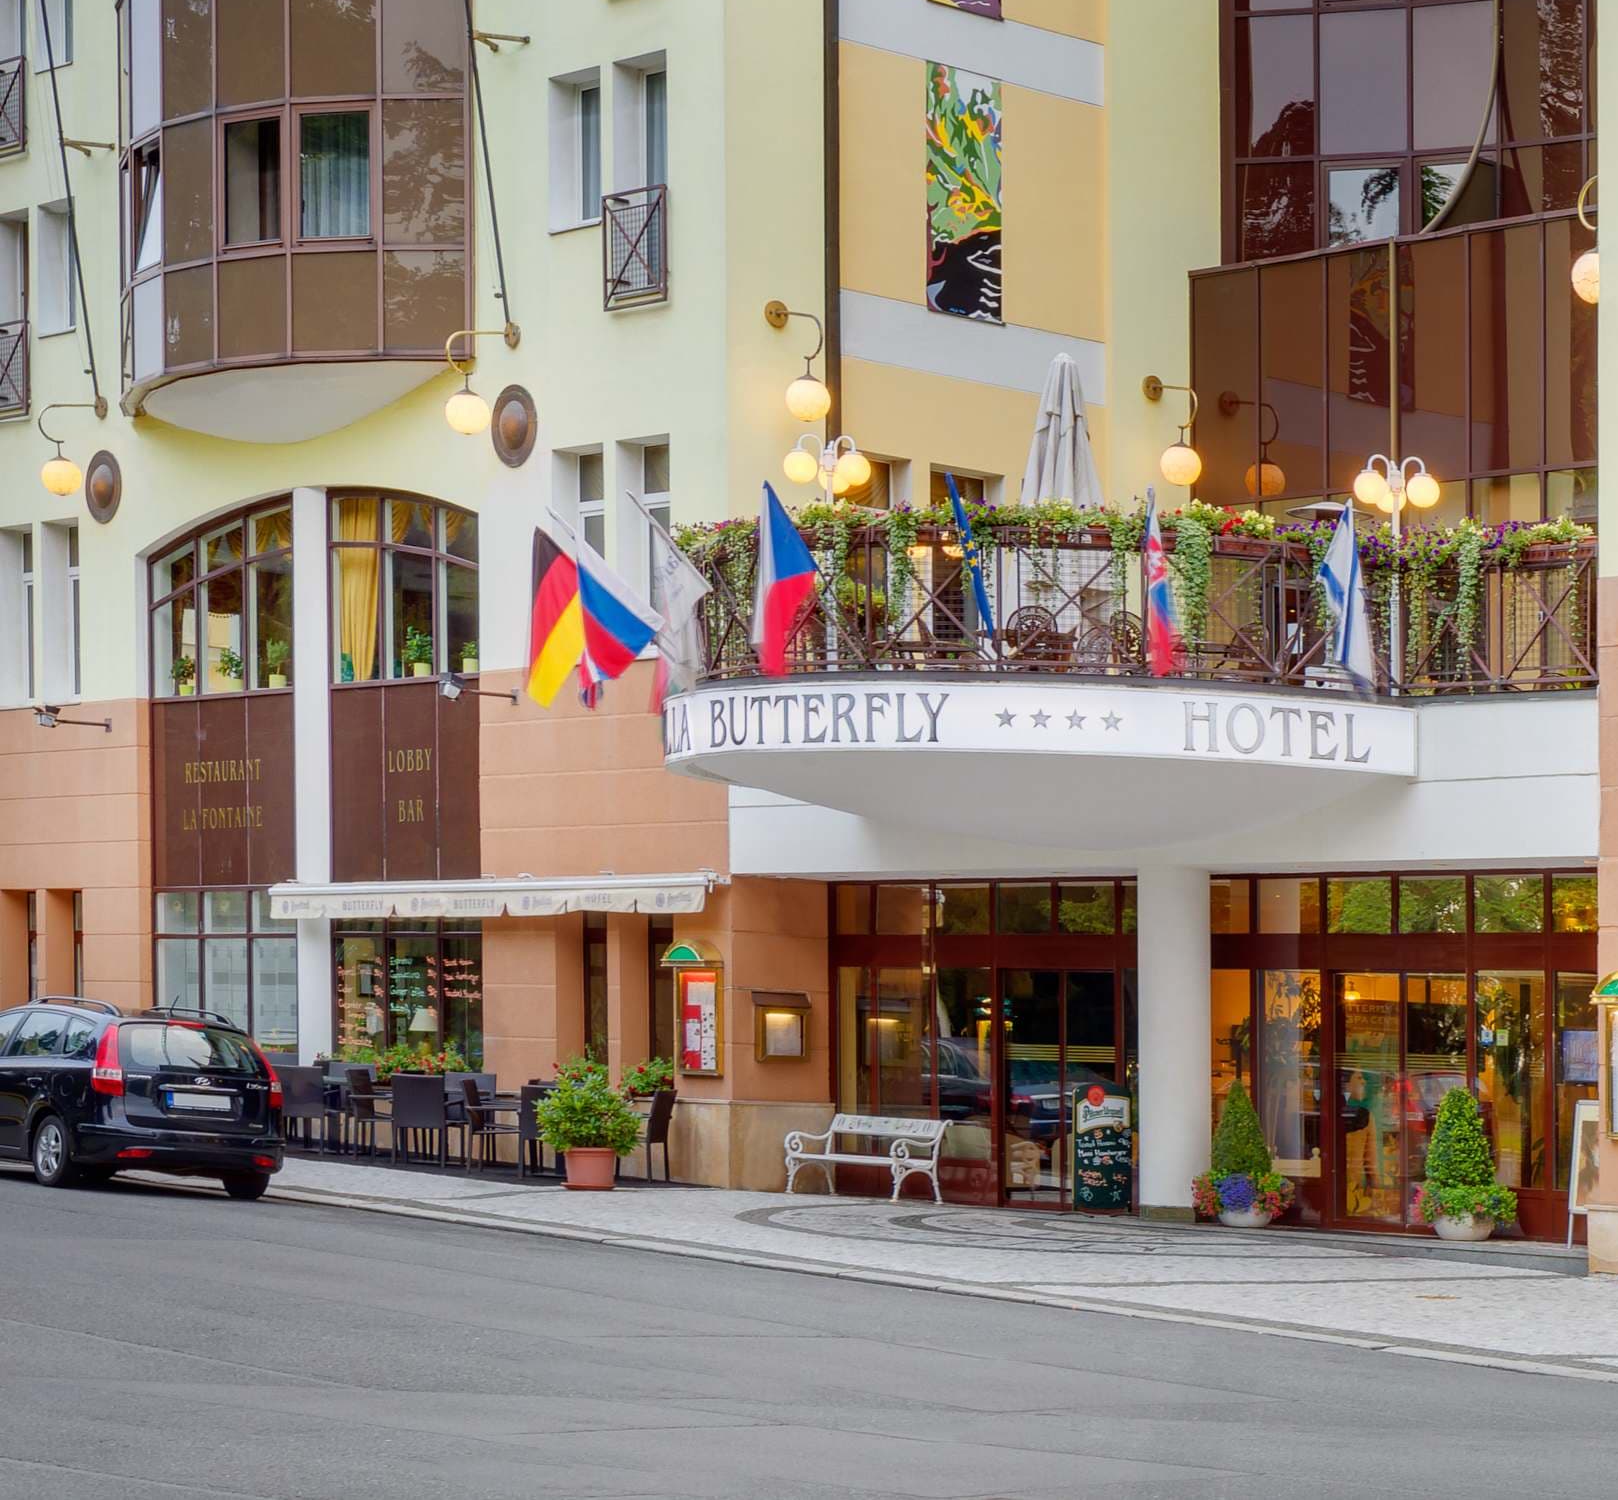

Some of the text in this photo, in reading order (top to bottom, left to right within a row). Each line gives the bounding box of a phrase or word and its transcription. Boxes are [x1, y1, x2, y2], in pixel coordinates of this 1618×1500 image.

[662, 692, 1372, 764] LLA BUTTERFLY HOTEL
[184, 758, 261, 784] RESTAURANT
[388, 748, 432, 773] LOBBY
[183, 806, 263, 831] LA FONTAINE
[398, 799, 424, 823] BAR
